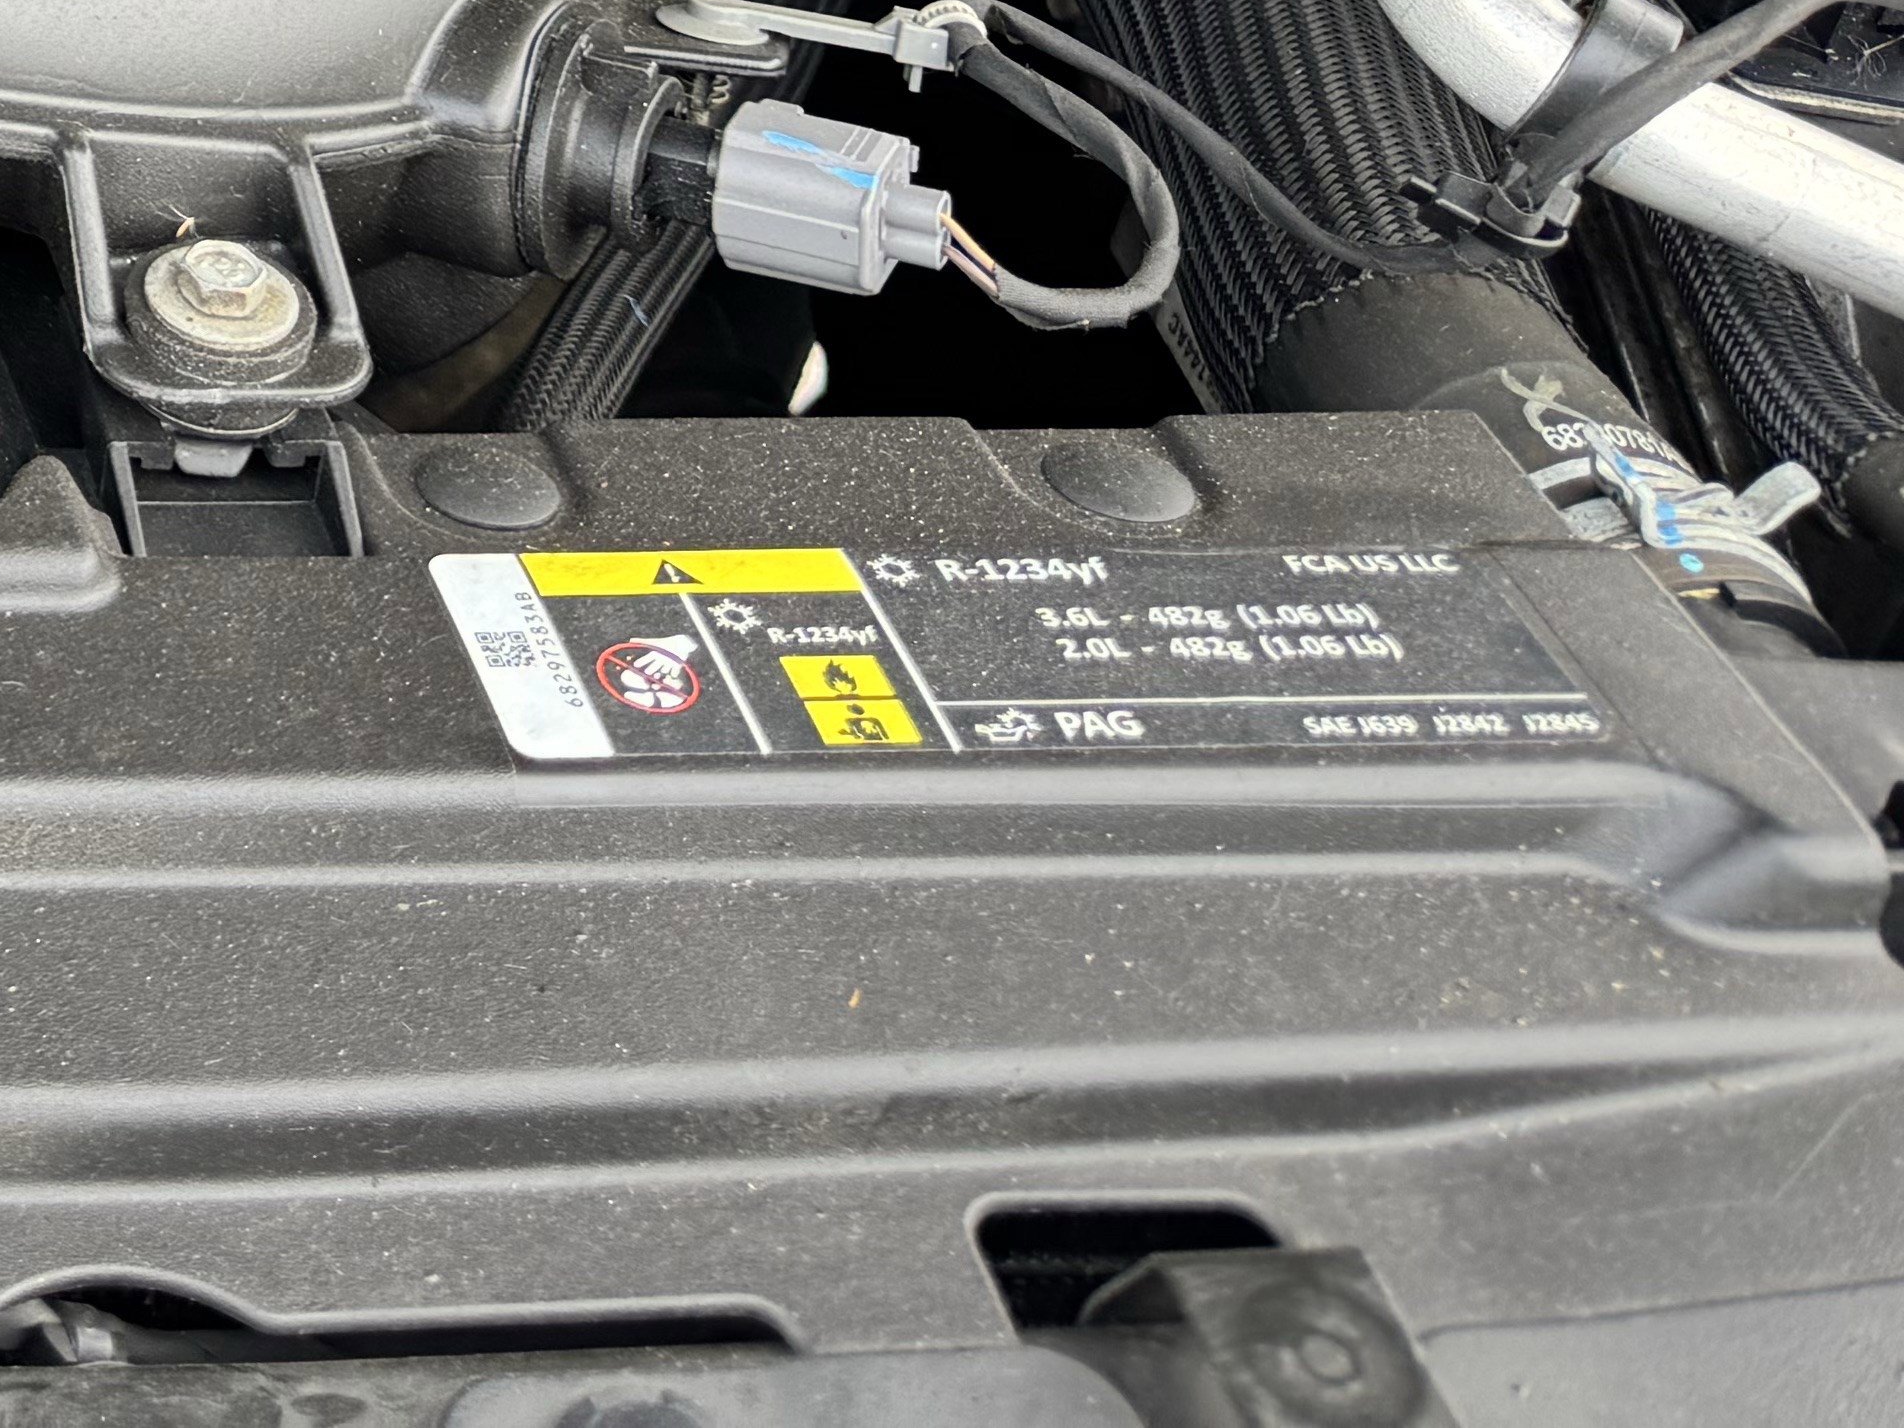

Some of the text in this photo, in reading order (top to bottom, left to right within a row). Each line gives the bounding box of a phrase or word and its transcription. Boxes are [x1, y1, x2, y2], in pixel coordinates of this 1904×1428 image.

[934, 555, 1109, 587] R-1234yf
[1282, 552, 1461, 574] FCA US LLC
[1035, 606, 1111, 629] 3.6L
[1147, 604, 1231, 631] 482g
[1235, 603, 1323, 630] (1.06
[1320, 602, 1382, 630] Lb)
[514, 591, 585, 708] 68297583AB
[766, 624, 880, 646] R-1234yf
[1055, 637, 1132, 661] 2.0L
[1168, 636, 1253, 662] 482g
[1258, 634, 1349, 662] (1.06
[1346, 634, 1405, 663] Lb)
[1053, 710, 1146, 742] PAG
[1301, 715, 1356, 737] SAE
